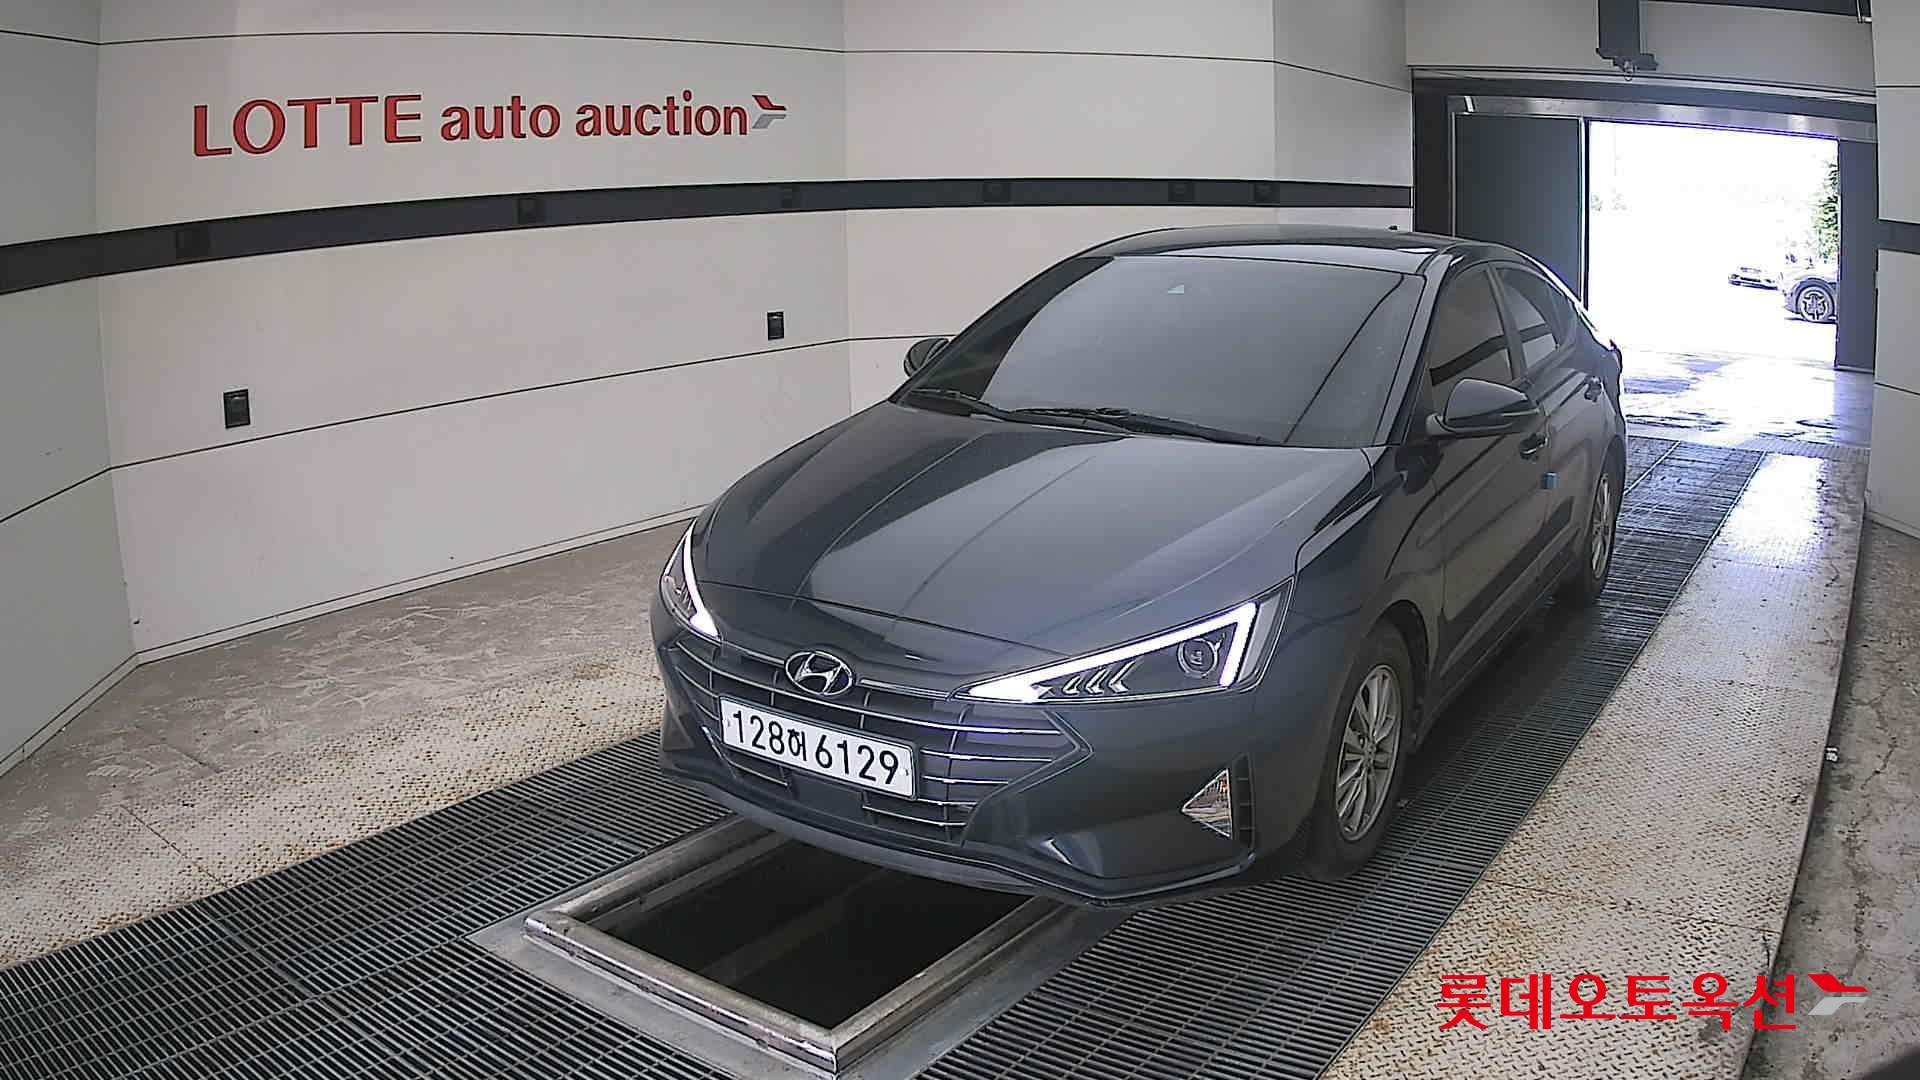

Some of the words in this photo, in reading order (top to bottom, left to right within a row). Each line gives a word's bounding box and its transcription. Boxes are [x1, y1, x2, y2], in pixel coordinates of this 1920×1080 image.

[192, 94, 423, 157] LOTTE
[440, 95, 561, 141] auto
[575, 89, 749, 137] auction
